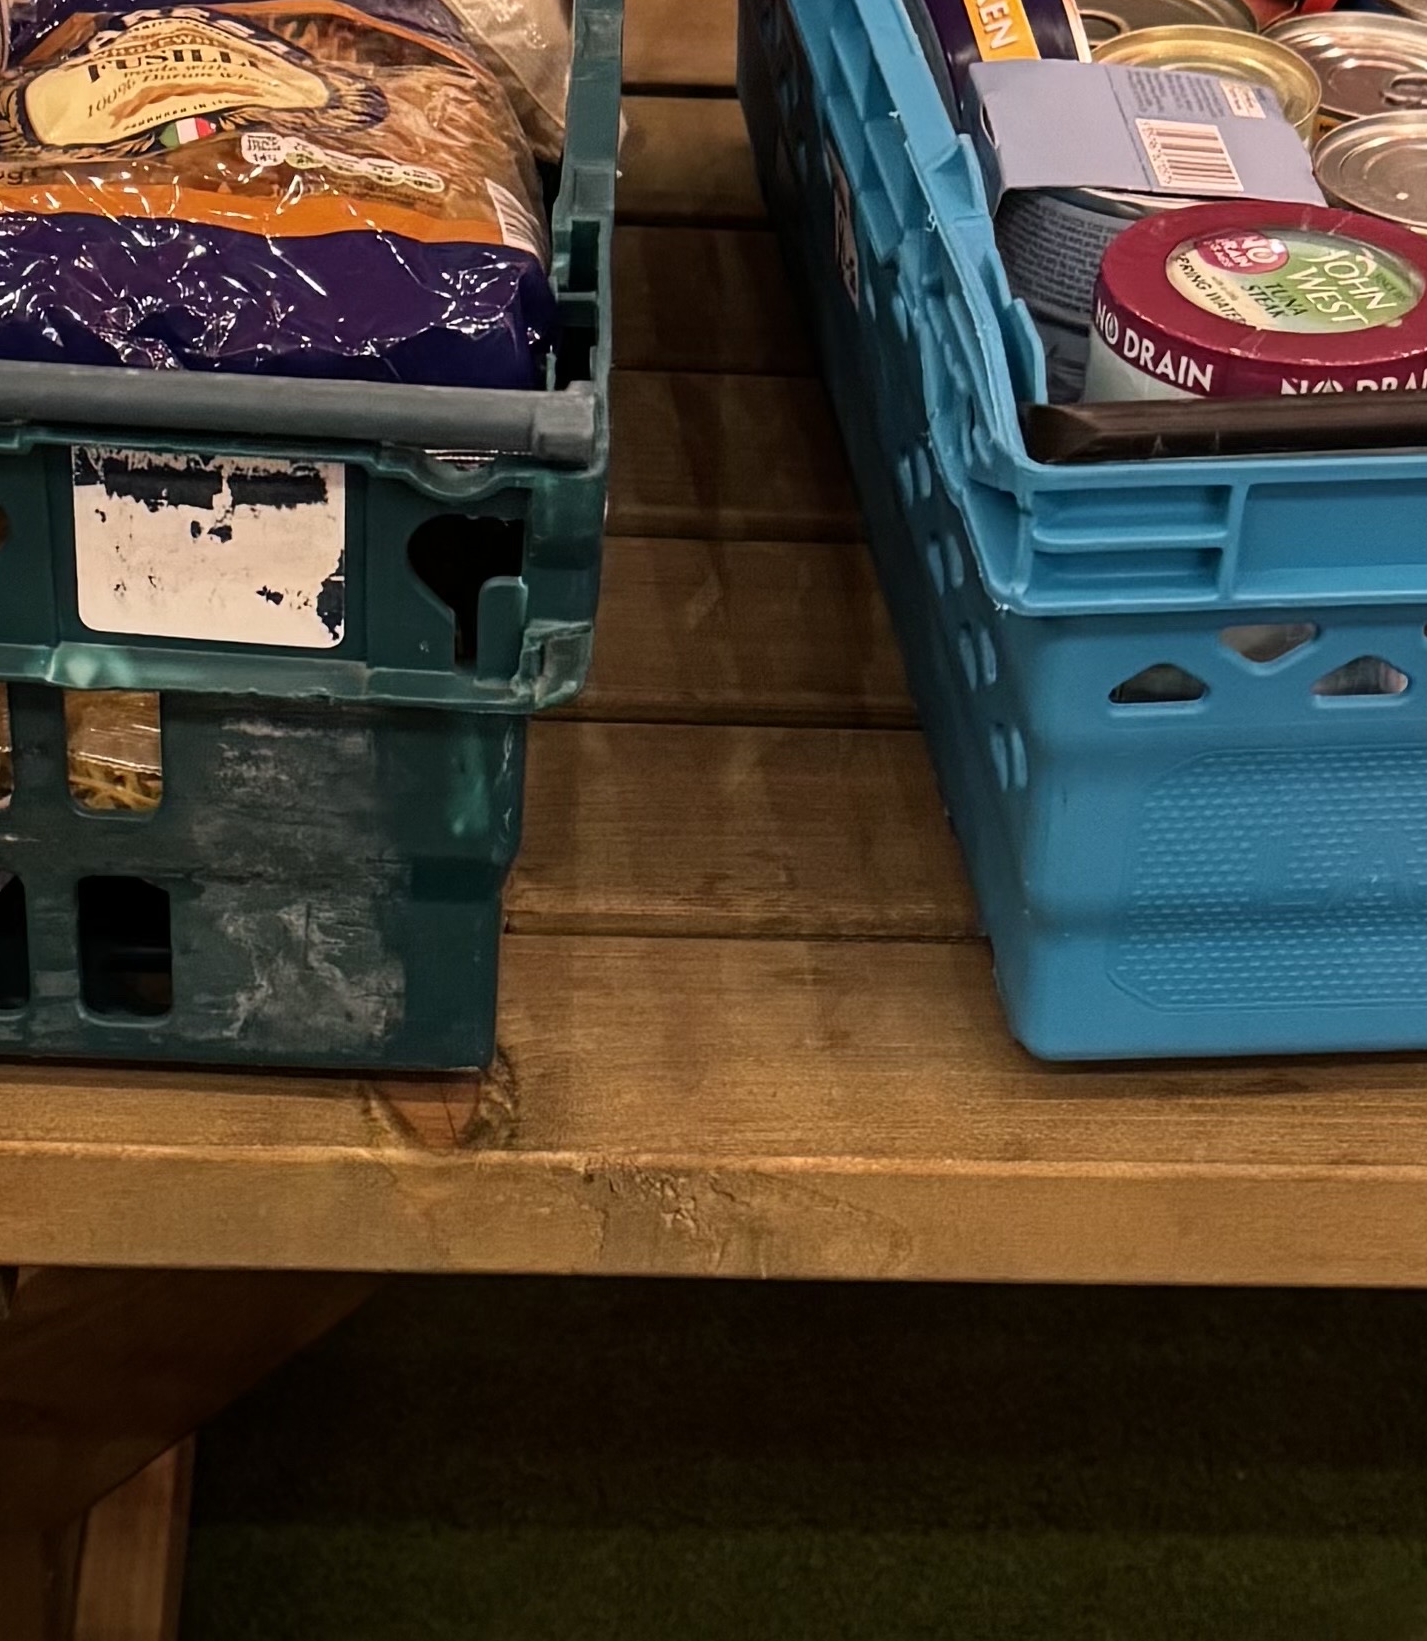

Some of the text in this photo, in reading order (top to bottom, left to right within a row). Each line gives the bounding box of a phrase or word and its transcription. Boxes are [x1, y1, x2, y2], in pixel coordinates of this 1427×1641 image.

[1240, 283, 1288, 320] STEAK
[1264, 280, 1309, 317] TUNA
[1286, 265, 1370, 325] WEST
[1305, 248, 1399, 311] JOHN
[1094, 299, 1214, 393] NO DRAIN
